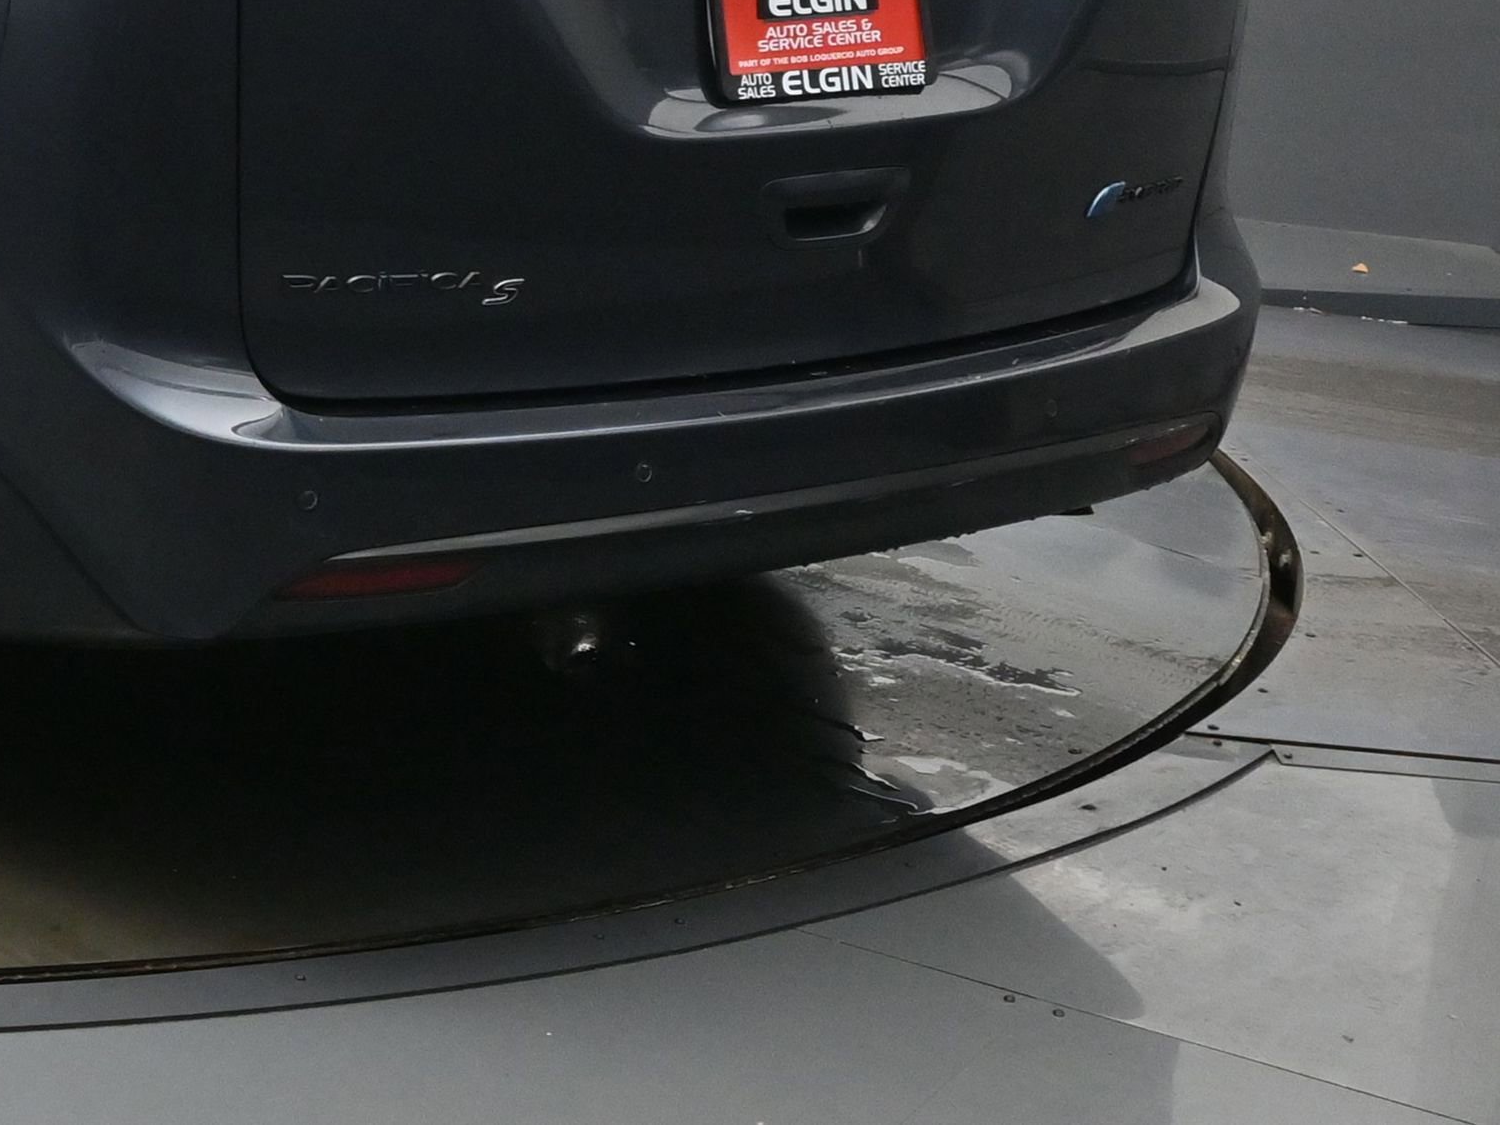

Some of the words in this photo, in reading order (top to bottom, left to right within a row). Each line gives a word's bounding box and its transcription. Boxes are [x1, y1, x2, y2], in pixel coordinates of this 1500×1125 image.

[765, 23, 808, 39] AUTO
[812, 19, 857, 35] SALES
[861, 18, 872, 31] &
[757, 35, 824, 53] SERVICE
[827, 30, 882, 46] CENTER
[738, 59, 758, 68] PART
[760, 58, 772, 66] OF
[772, 56, 789, 65] THE
[790, 55, 808, 64] BOB
[856, 49, 876, 57] AUTO
[877, 46, 904, 56] GROUP
[878, 60, 926, 75] SERVICE
[740, 73, 772, 86] AUTO
[782, 64, 874, 96] ELGIN
[881, 73, 926, 88] CENTER
[737, 85, 776, 100] SALES
[281, 270, 482, 294] PACIFICA
[481, 277, 526, 306] S
